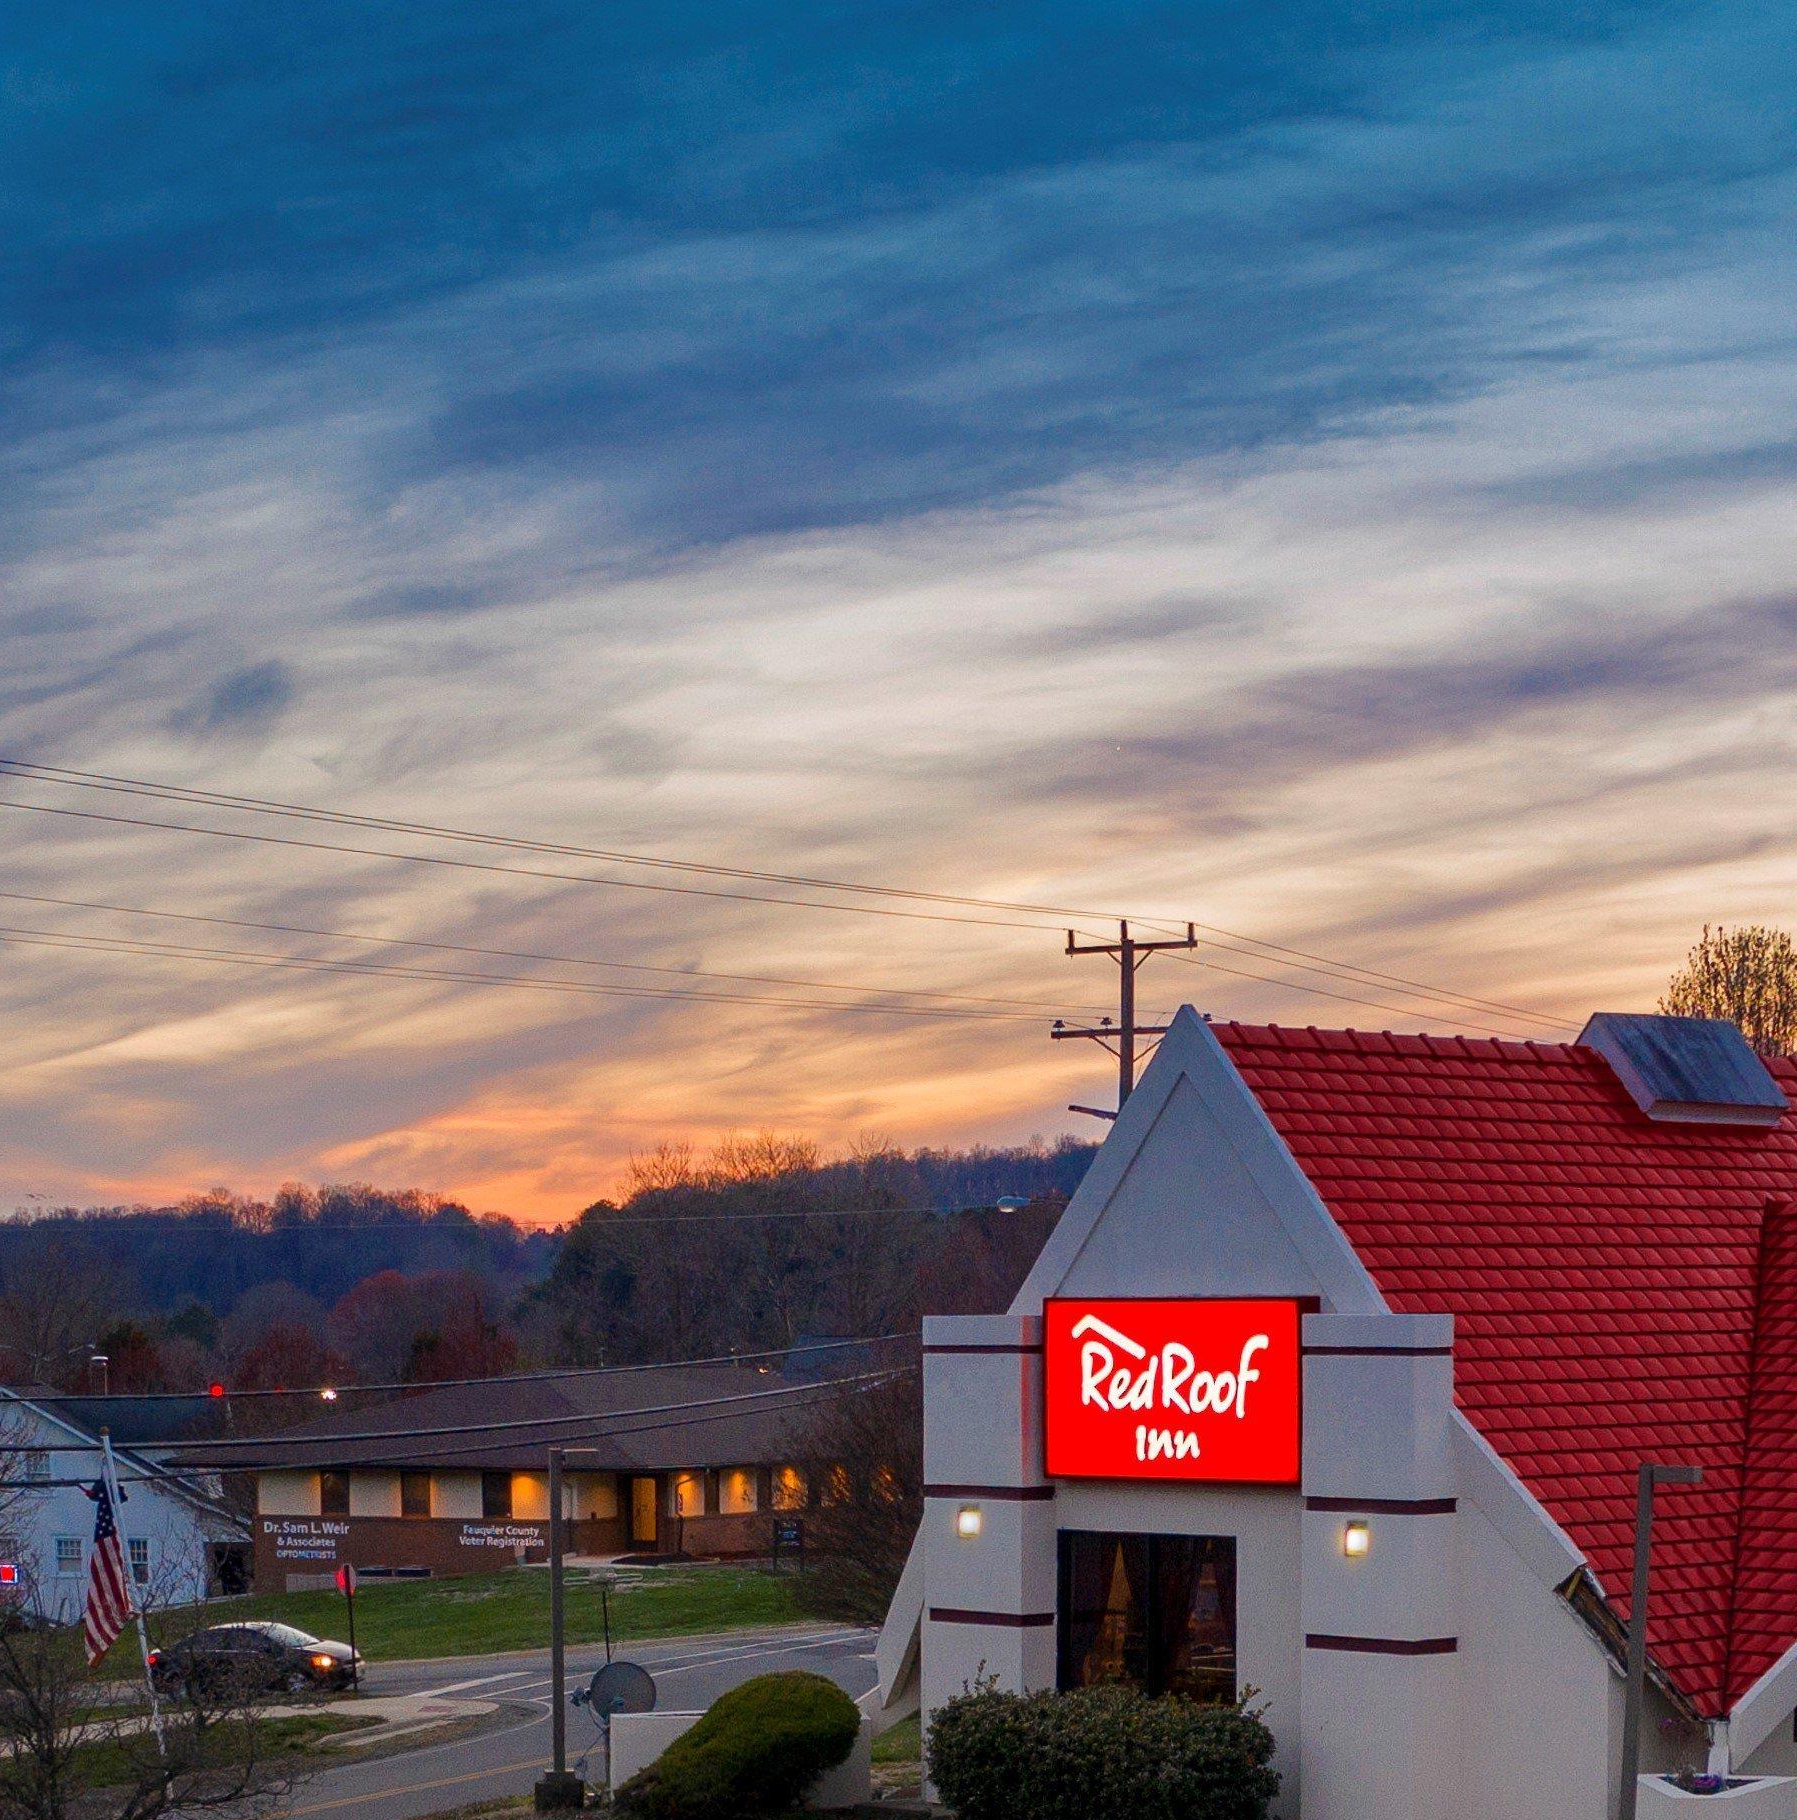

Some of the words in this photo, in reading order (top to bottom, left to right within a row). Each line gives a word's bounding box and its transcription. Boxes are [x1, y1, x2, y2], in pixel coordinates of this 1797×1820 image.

[1080, 1340, 1158, 1412] Red
[1161, 1334, 1269, 1419] Roof
[263, 1521, 282, 1533] Dr.
[282, 1521, 309, 1534] Sam
[310, 1521, 321, 1534] L.
[321, 1522, 350, 1534] Weir
[506, 1525, 540, 1538] County
[276, 1536, 286, 1546] &
[286, 1536, 336, 1547] Associates
[459, 1535, 486, 1546] Voter
[486, 1536, 545, 1548] Registration
